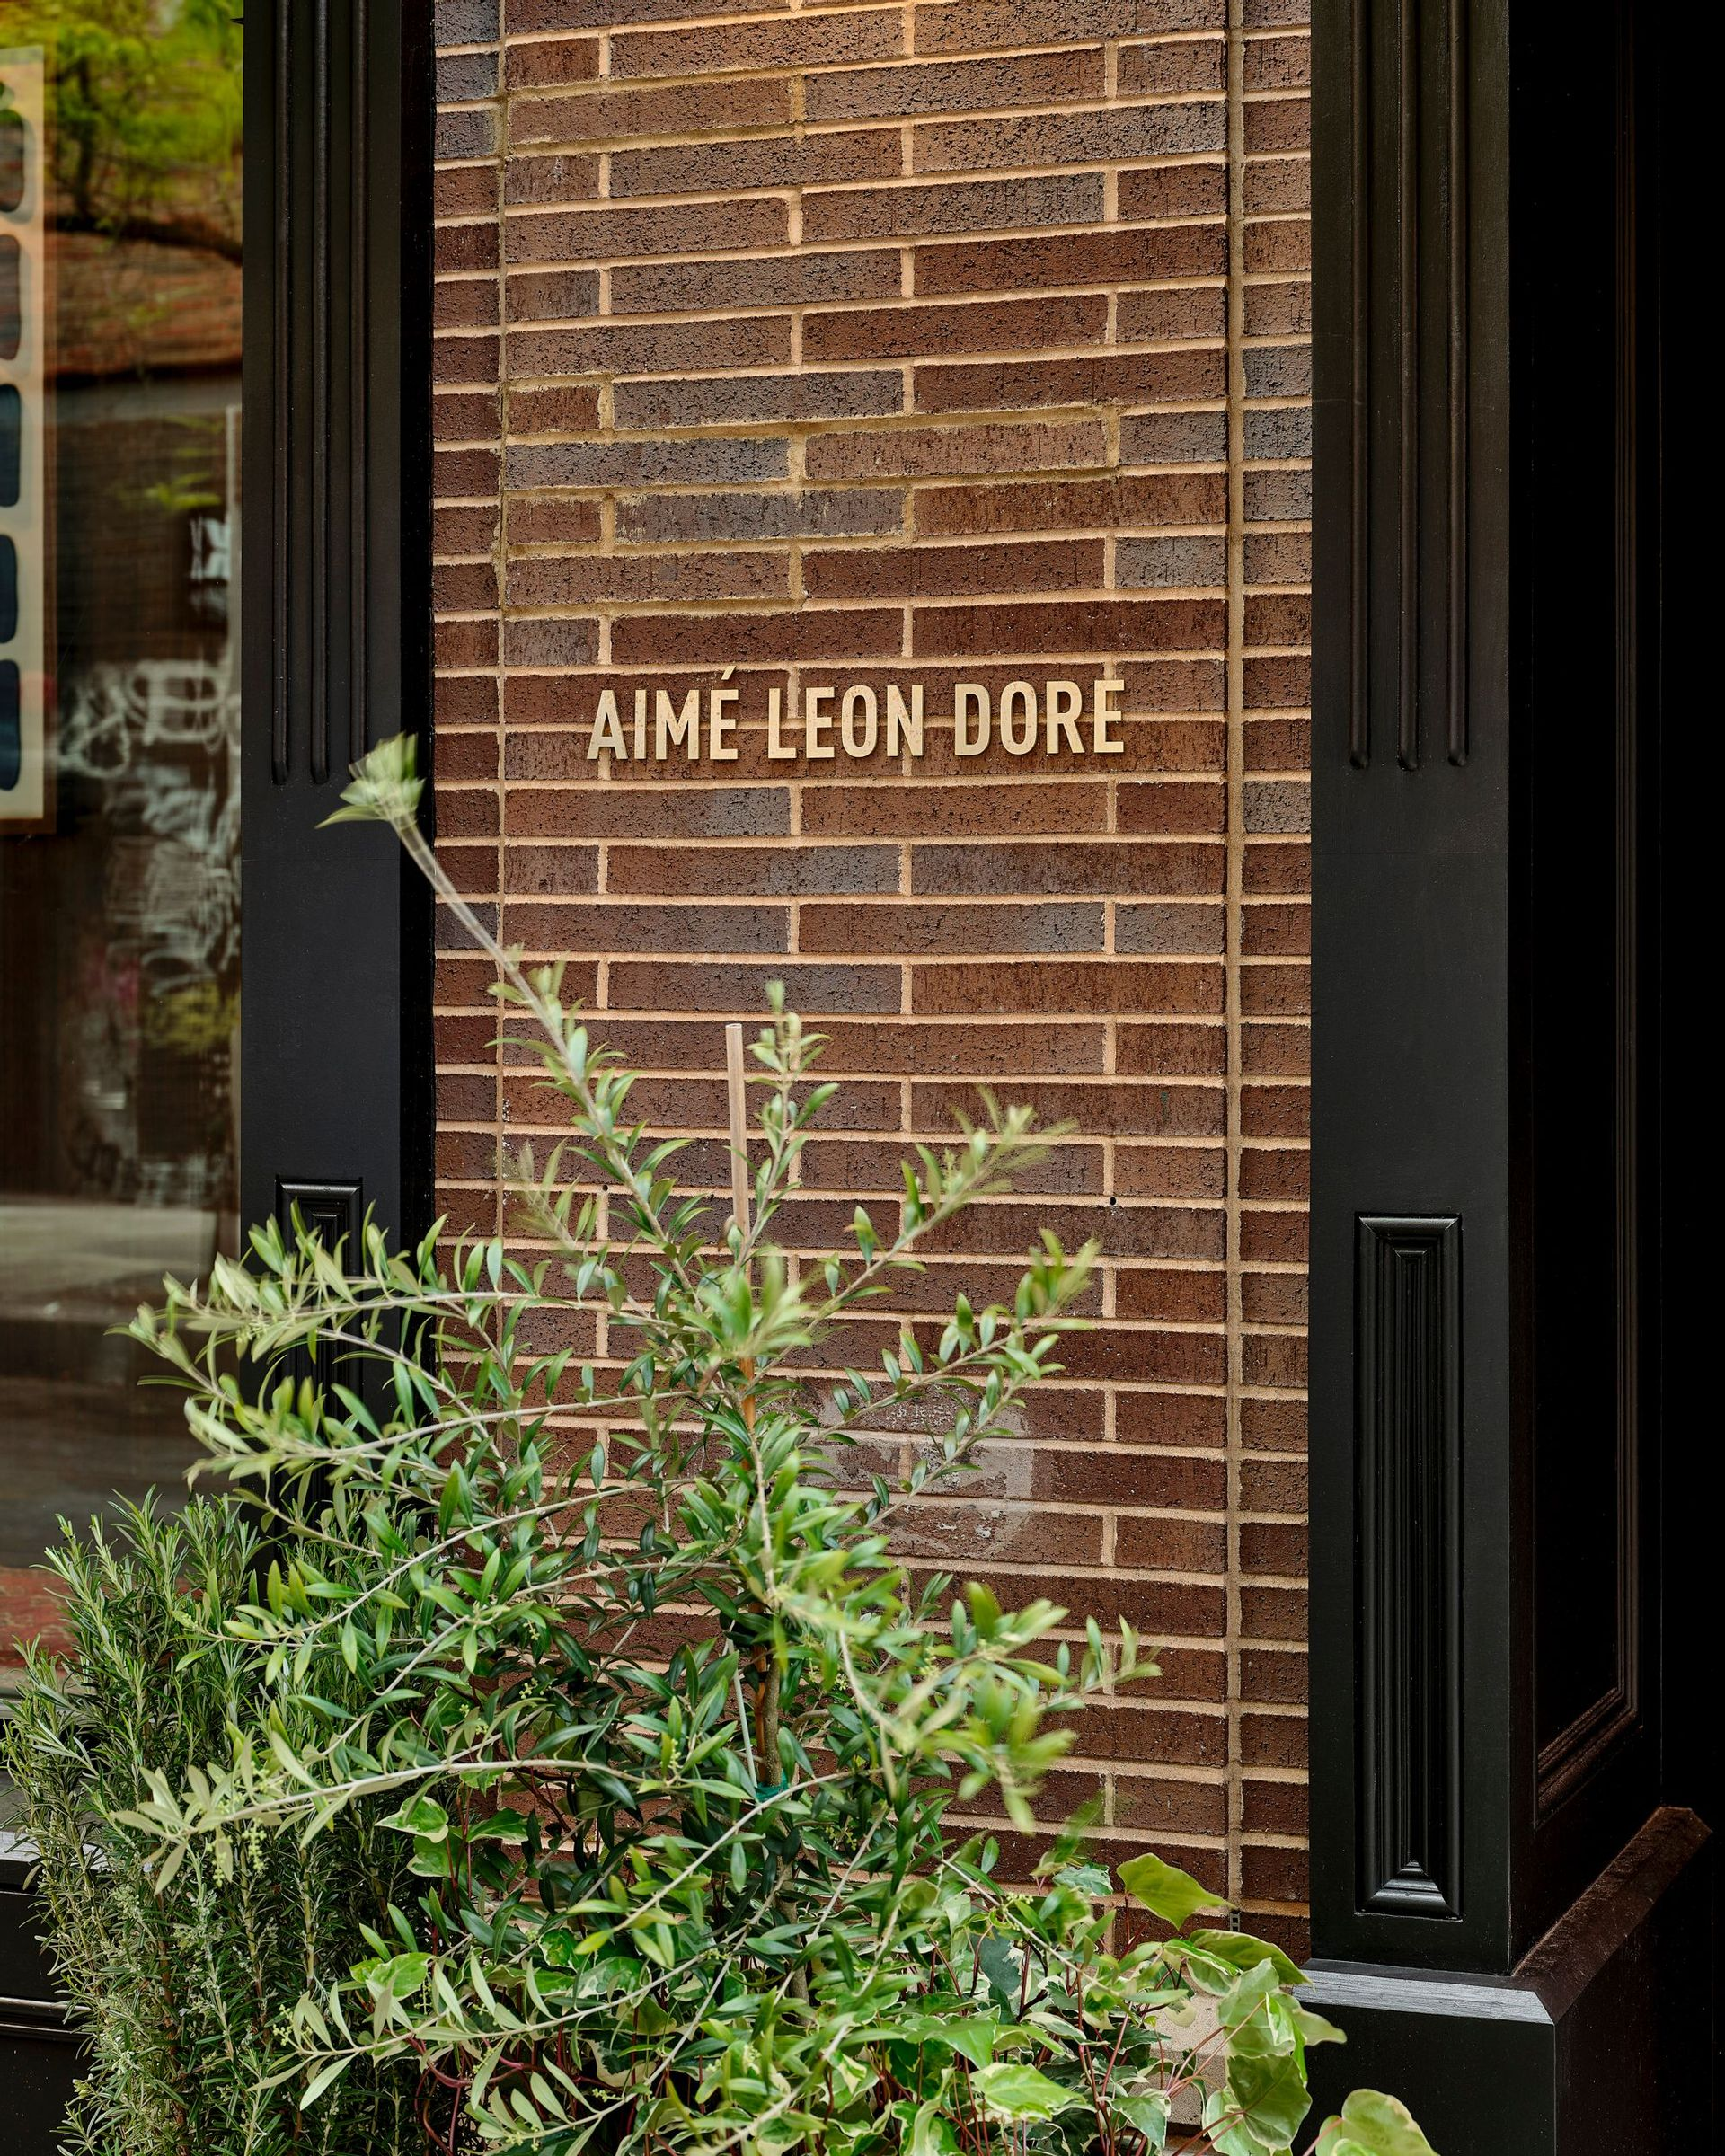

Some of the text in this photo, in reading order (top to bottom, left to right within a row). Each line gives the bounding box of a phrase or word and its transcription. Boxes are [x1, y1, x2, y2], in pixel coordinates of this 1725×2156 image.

[586, 666, 1125, 761] AIMÉ LEON DORE
